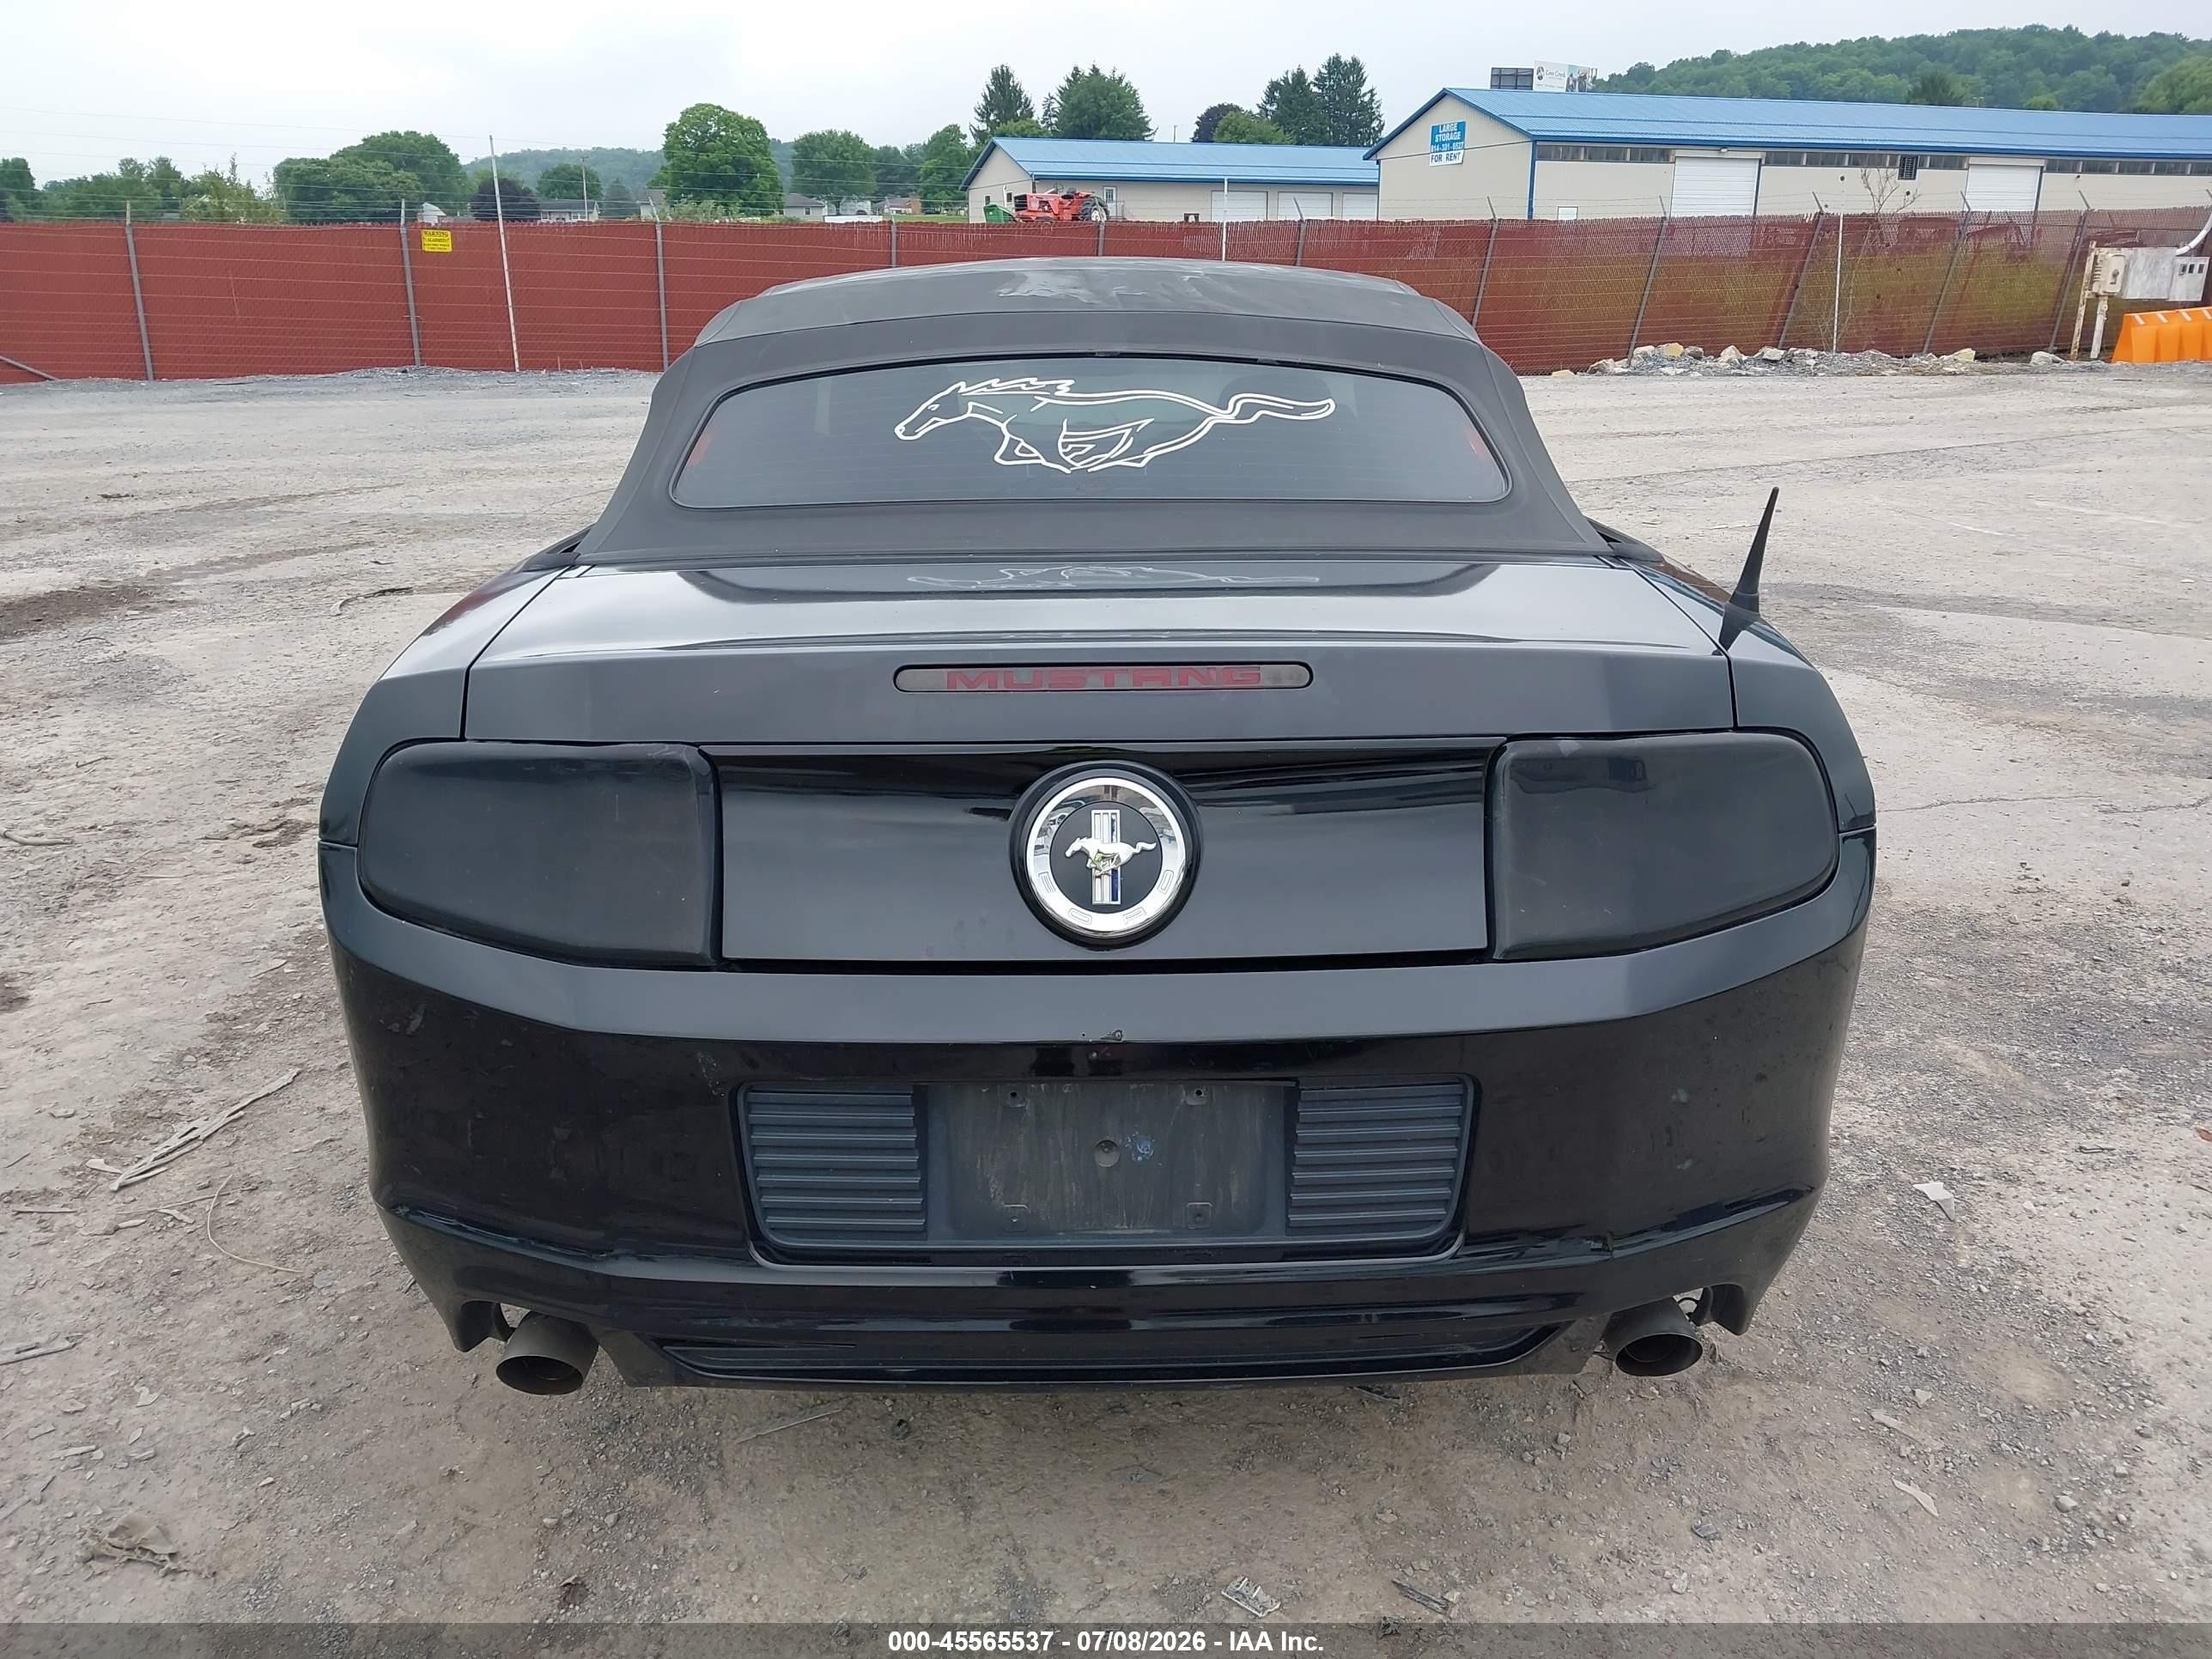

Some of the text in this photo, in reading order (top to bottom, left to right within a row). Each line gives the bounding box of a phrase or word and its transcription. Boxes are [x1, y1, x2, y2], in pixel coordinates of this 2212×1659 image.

[1439, 123, 1458, 133] LARGE
[1435, 131, 1462, 143] STORAGE
[1431, 152, 1461, 163] FOR RENT
[946, 665, 1261, 690] MUSTANG
[1038, 870, 1174, 925] FORD
